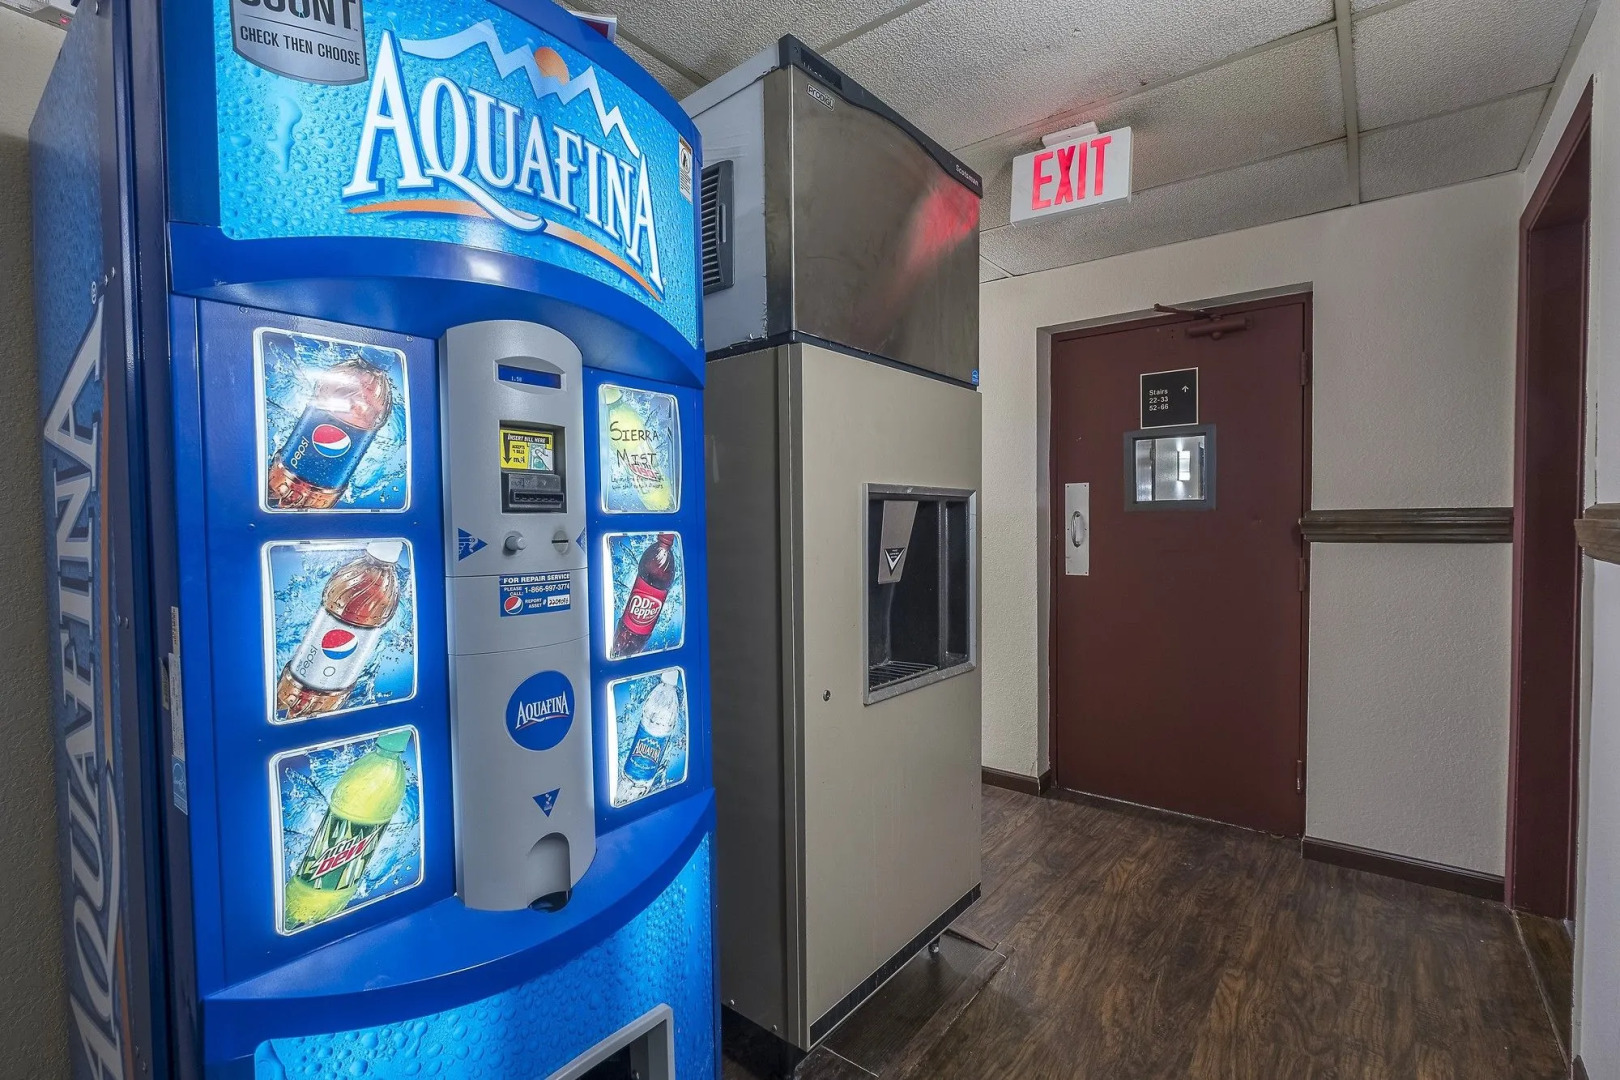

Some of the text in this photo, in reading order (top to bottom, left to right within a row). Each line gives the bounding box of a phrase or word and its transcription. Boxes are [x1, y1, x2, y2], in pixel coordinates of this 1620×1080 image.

[240, 26, 361, 66] CHECK THEN CHOOSE
[342, 29, 664, 293] AQUAFINA
[1031, 135, 1112, 211] EXIT
[1149, 396, 1169, 404] 22-33
[508, 434, 524, 442] INSERT
[609, 421, 661, 442] SIERRA
[290, 436, 310, 469] pepsi
[616, 448, 657, 467] MIST
[520, 575, 546, 583] REPAIR
[546, 573, 570, 581] SERVICE
[630, 595, 660, 619] Pepper
[642, 597, 656, 609] Dr
[299, 644, 318, 678] pepsi
[515, 690, 570, 730] AQUAFINA
